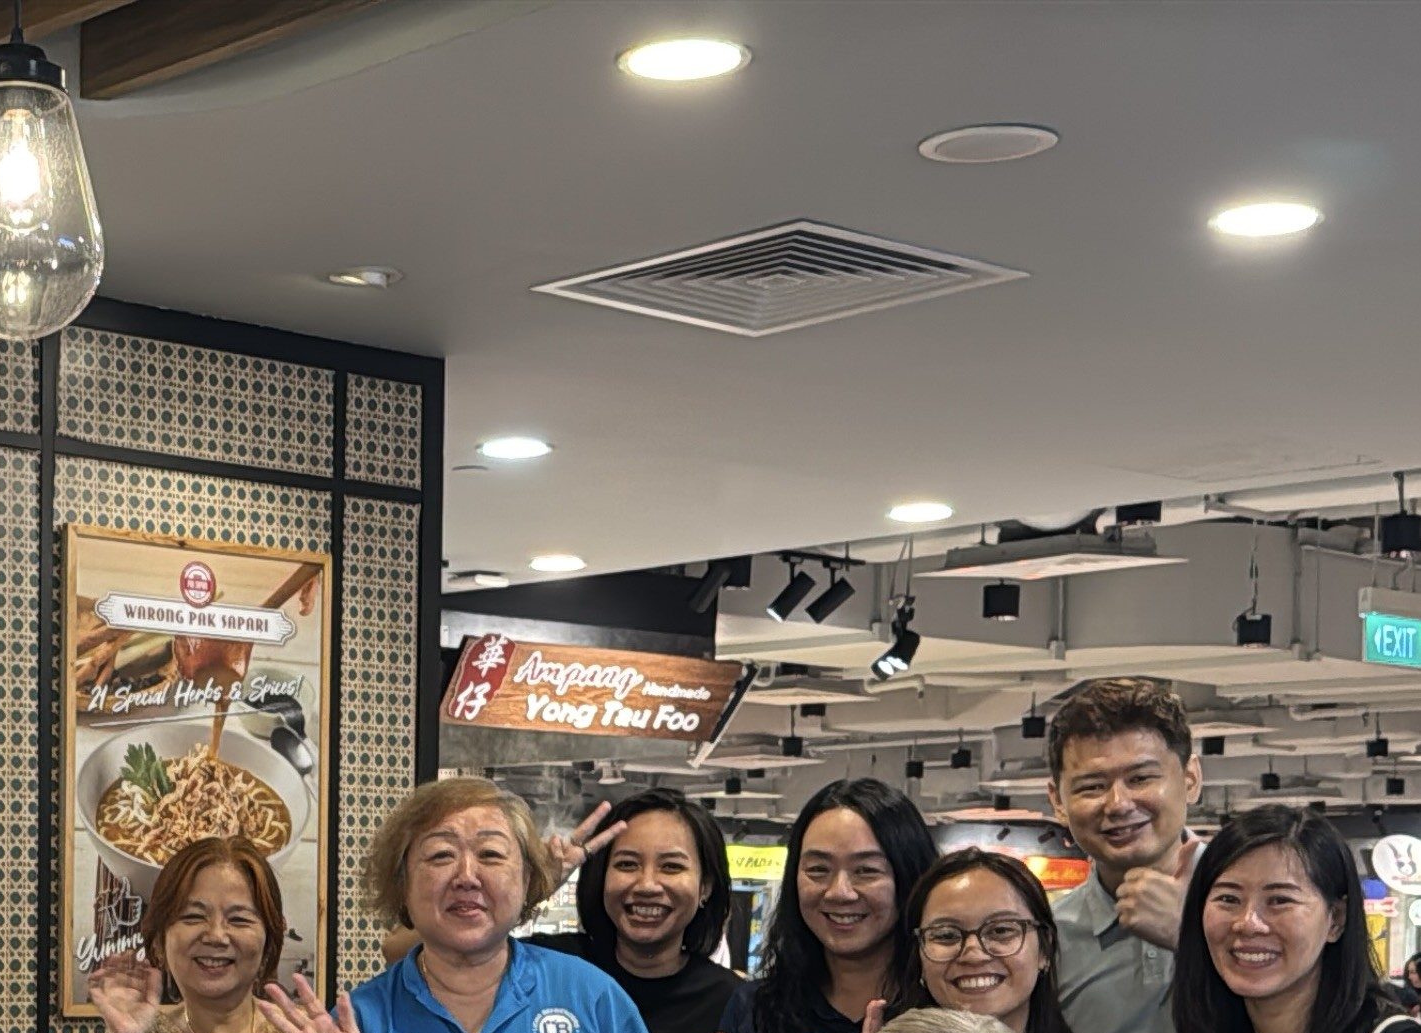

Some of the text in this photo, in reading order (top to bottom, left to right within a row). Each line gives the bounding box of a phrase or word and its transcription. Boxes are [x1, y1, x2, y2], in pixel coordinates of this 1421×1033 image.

[124, 604, 269, 632] WARONG PAK SAPARI
[1383, 625, 1417, 658] EXIT
[112, 681, 169, 713] Special
[173, 676, 223, 707] Herbs
[249, 672, 305, 703] Spices!
[525, 693, 598, 728] Yong
[652, 704, 700, 732] Foo
